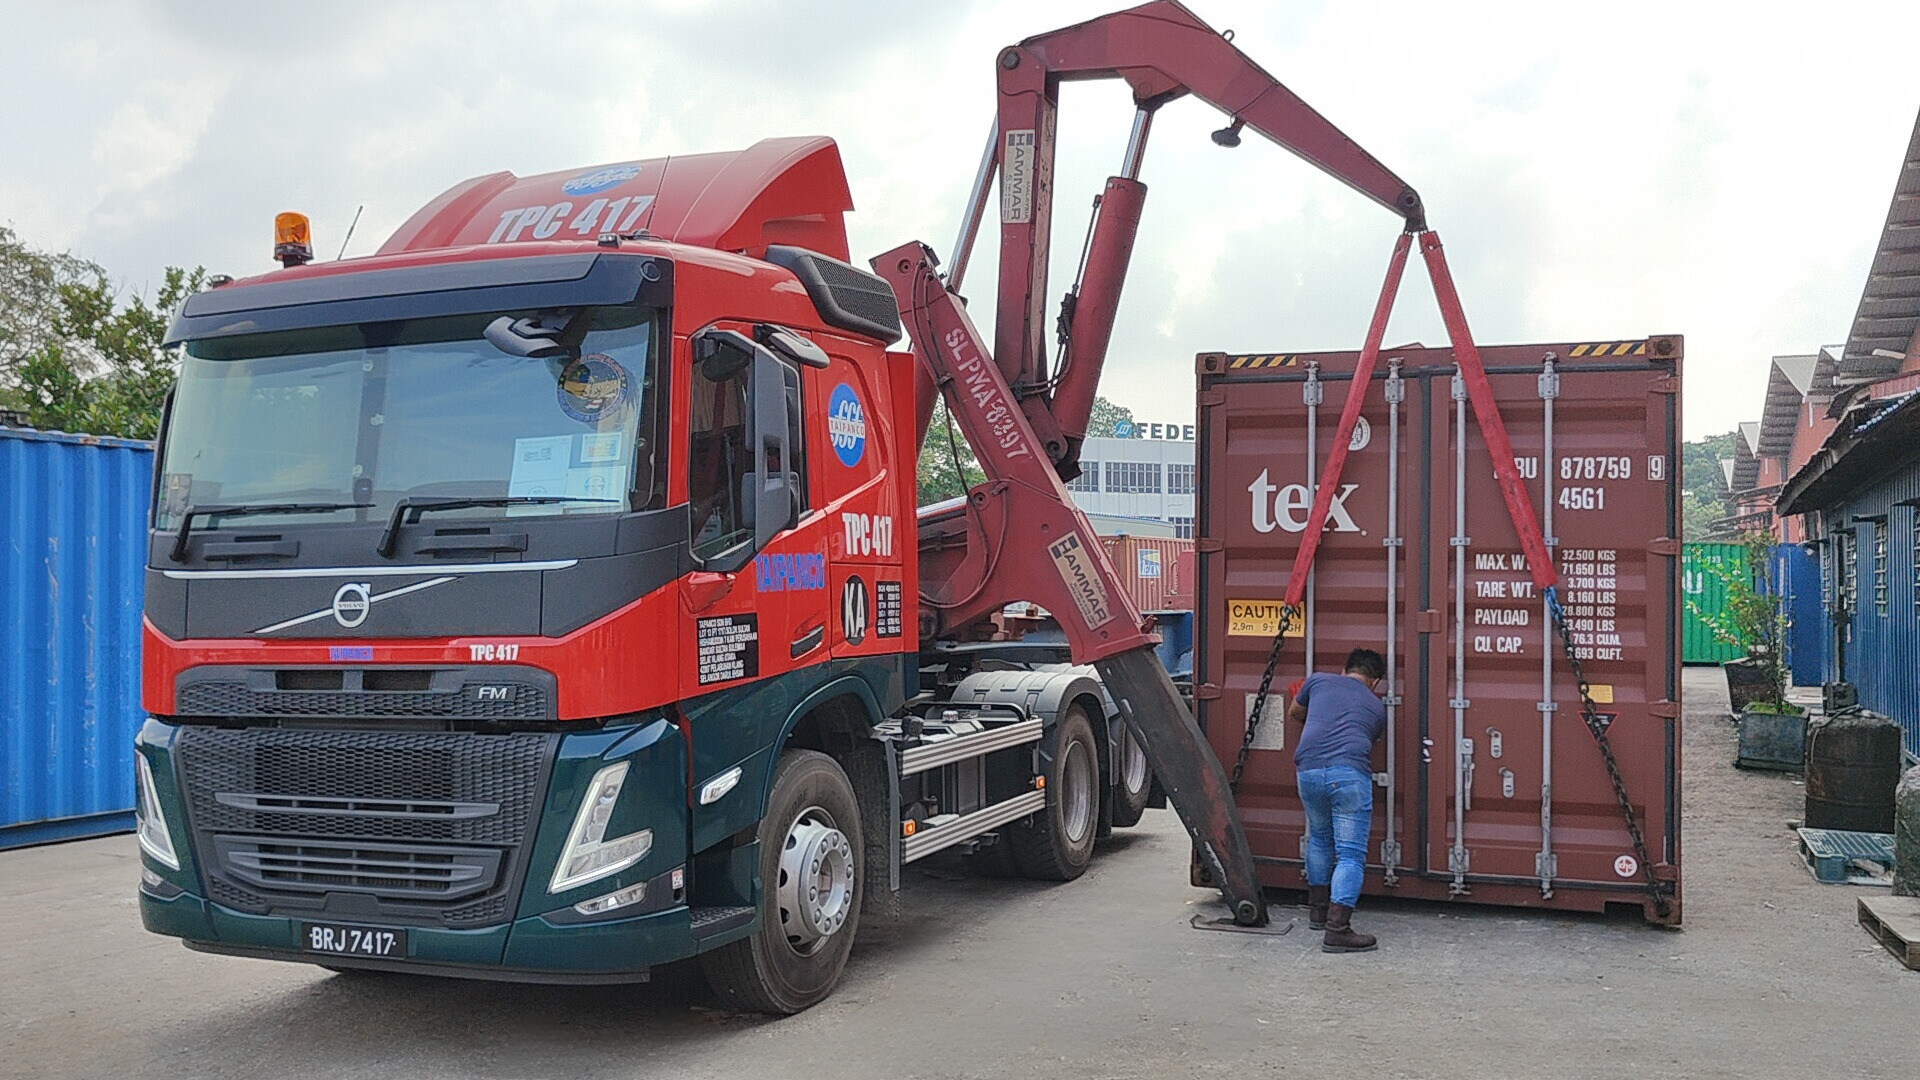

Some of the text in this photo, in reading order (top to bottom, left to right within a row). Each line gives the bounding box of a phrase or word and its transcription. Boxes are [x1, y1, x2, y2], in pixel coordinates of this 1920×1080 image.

[1011, 133, 1025, 220] HAMMAR
[487, 195, 656, 244] TPC 417
[945, 328, 970, 361] SL
[830, 420, 865, 436] TAIPANCO
[1136, 422, 1195, 440] FEDE
[1560, 457, 1631, 480] 878759
[1651, 457, 1662, 479] 9
[1559, 487, 1604, 510] 45G1
[842, 512, 892, 557] TPC 417
[1475, 554, 1508, 570] MAX.
[1561, 549, 1616, 561] 32.500 KGS
[754, 553, 824, 592] TAIPANCO
[1561, 562, 1616, 576] 71.650 LBS
[1058, 540, 1107, 622] HAMMAR
[1475, 581, 1537, 598] TARE WT.
[1567, 577, 1616, 590] 3.700 KGS
[1567, 590, 1616, 604] 8.160 LBS
[844, 582, 866, 638] KA
[1474, 608, 1529, 626] PAYLOAD
[1561, 605, 1615, 617] 28.800 KGS
[1596, 619, 1615, 631] LBS
[1474, 635, 1524, 653] CU. CAP.
[1573, 633, 1593, 645] 76.3
[469, 643, 519, 662] TPC 417
[478, 686, 508, 700] FM
[311, 926, 395, 955] BRJ 7417
